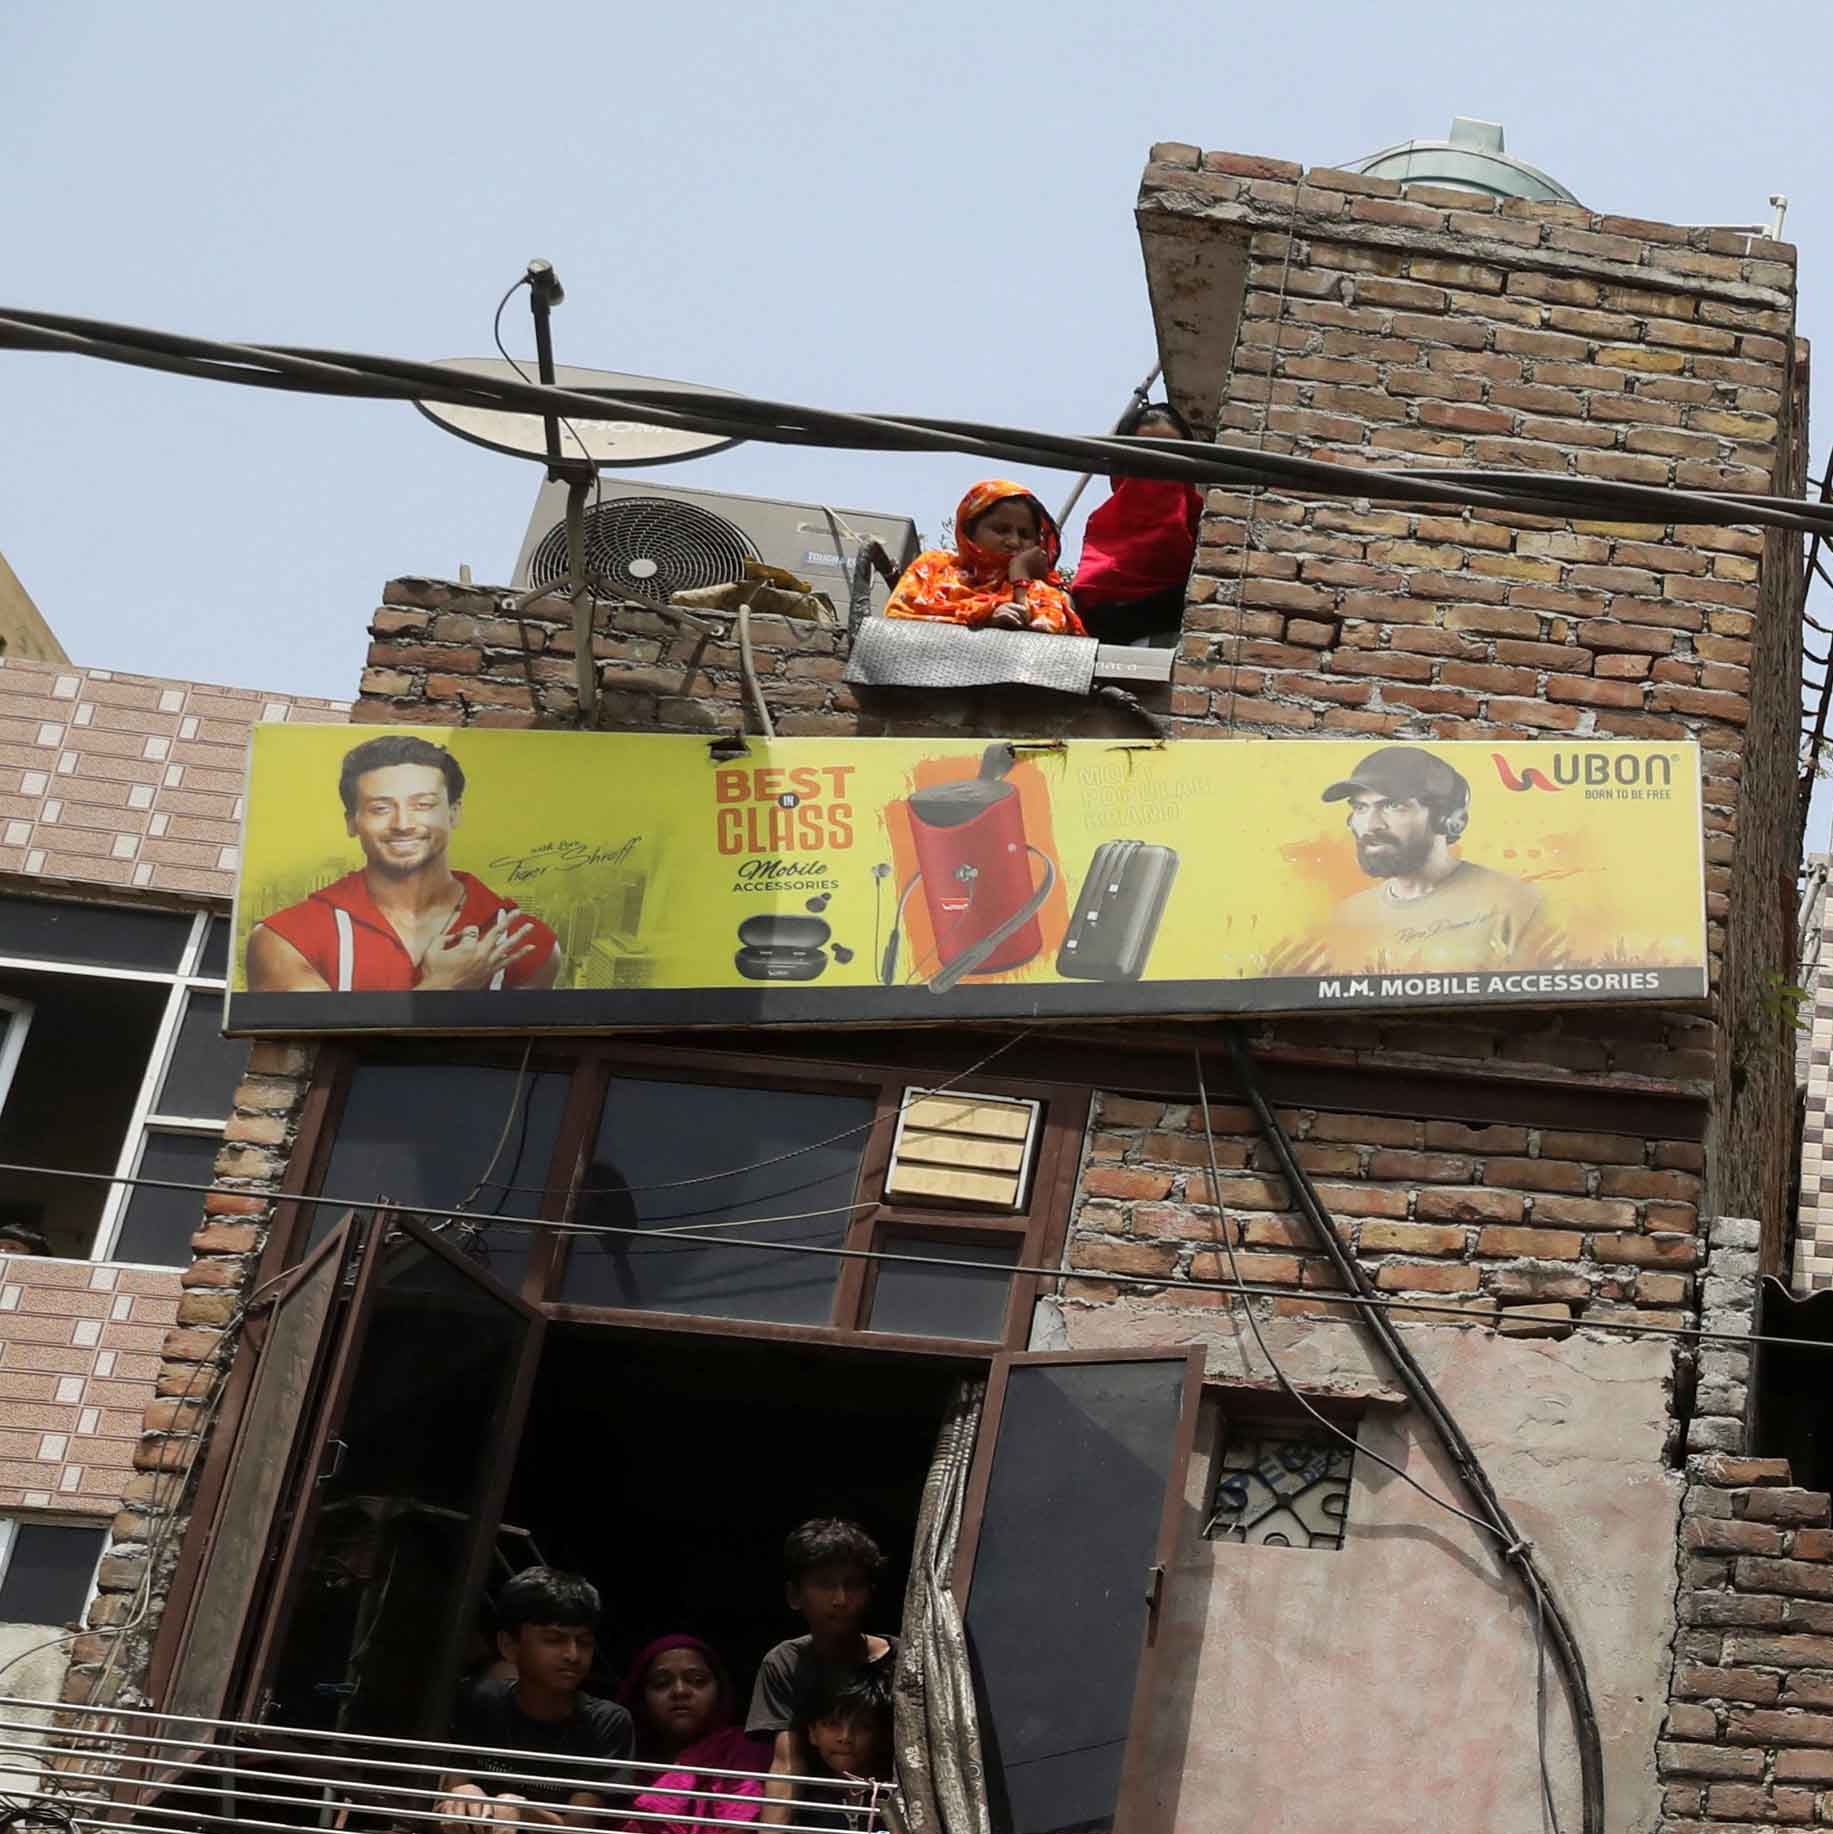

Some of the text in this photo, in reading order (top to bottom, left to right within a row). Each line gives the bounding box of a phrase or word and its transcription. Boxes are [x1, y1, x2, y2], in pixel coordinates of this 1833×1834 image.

[1553, 753, 1671, 785] UBON
[715, 765, 856, 804] BEST
[1584, 788, 1672, 801] BORN TO BE FREE
[716, 802, 854, 856] CLASS
[738, 859, 828, 880] Mobile
[733, 879, 840, 892] ACCESSORIES
[1318, 971, 1660, 999] M.M. MOBILE ACCESSORIES
